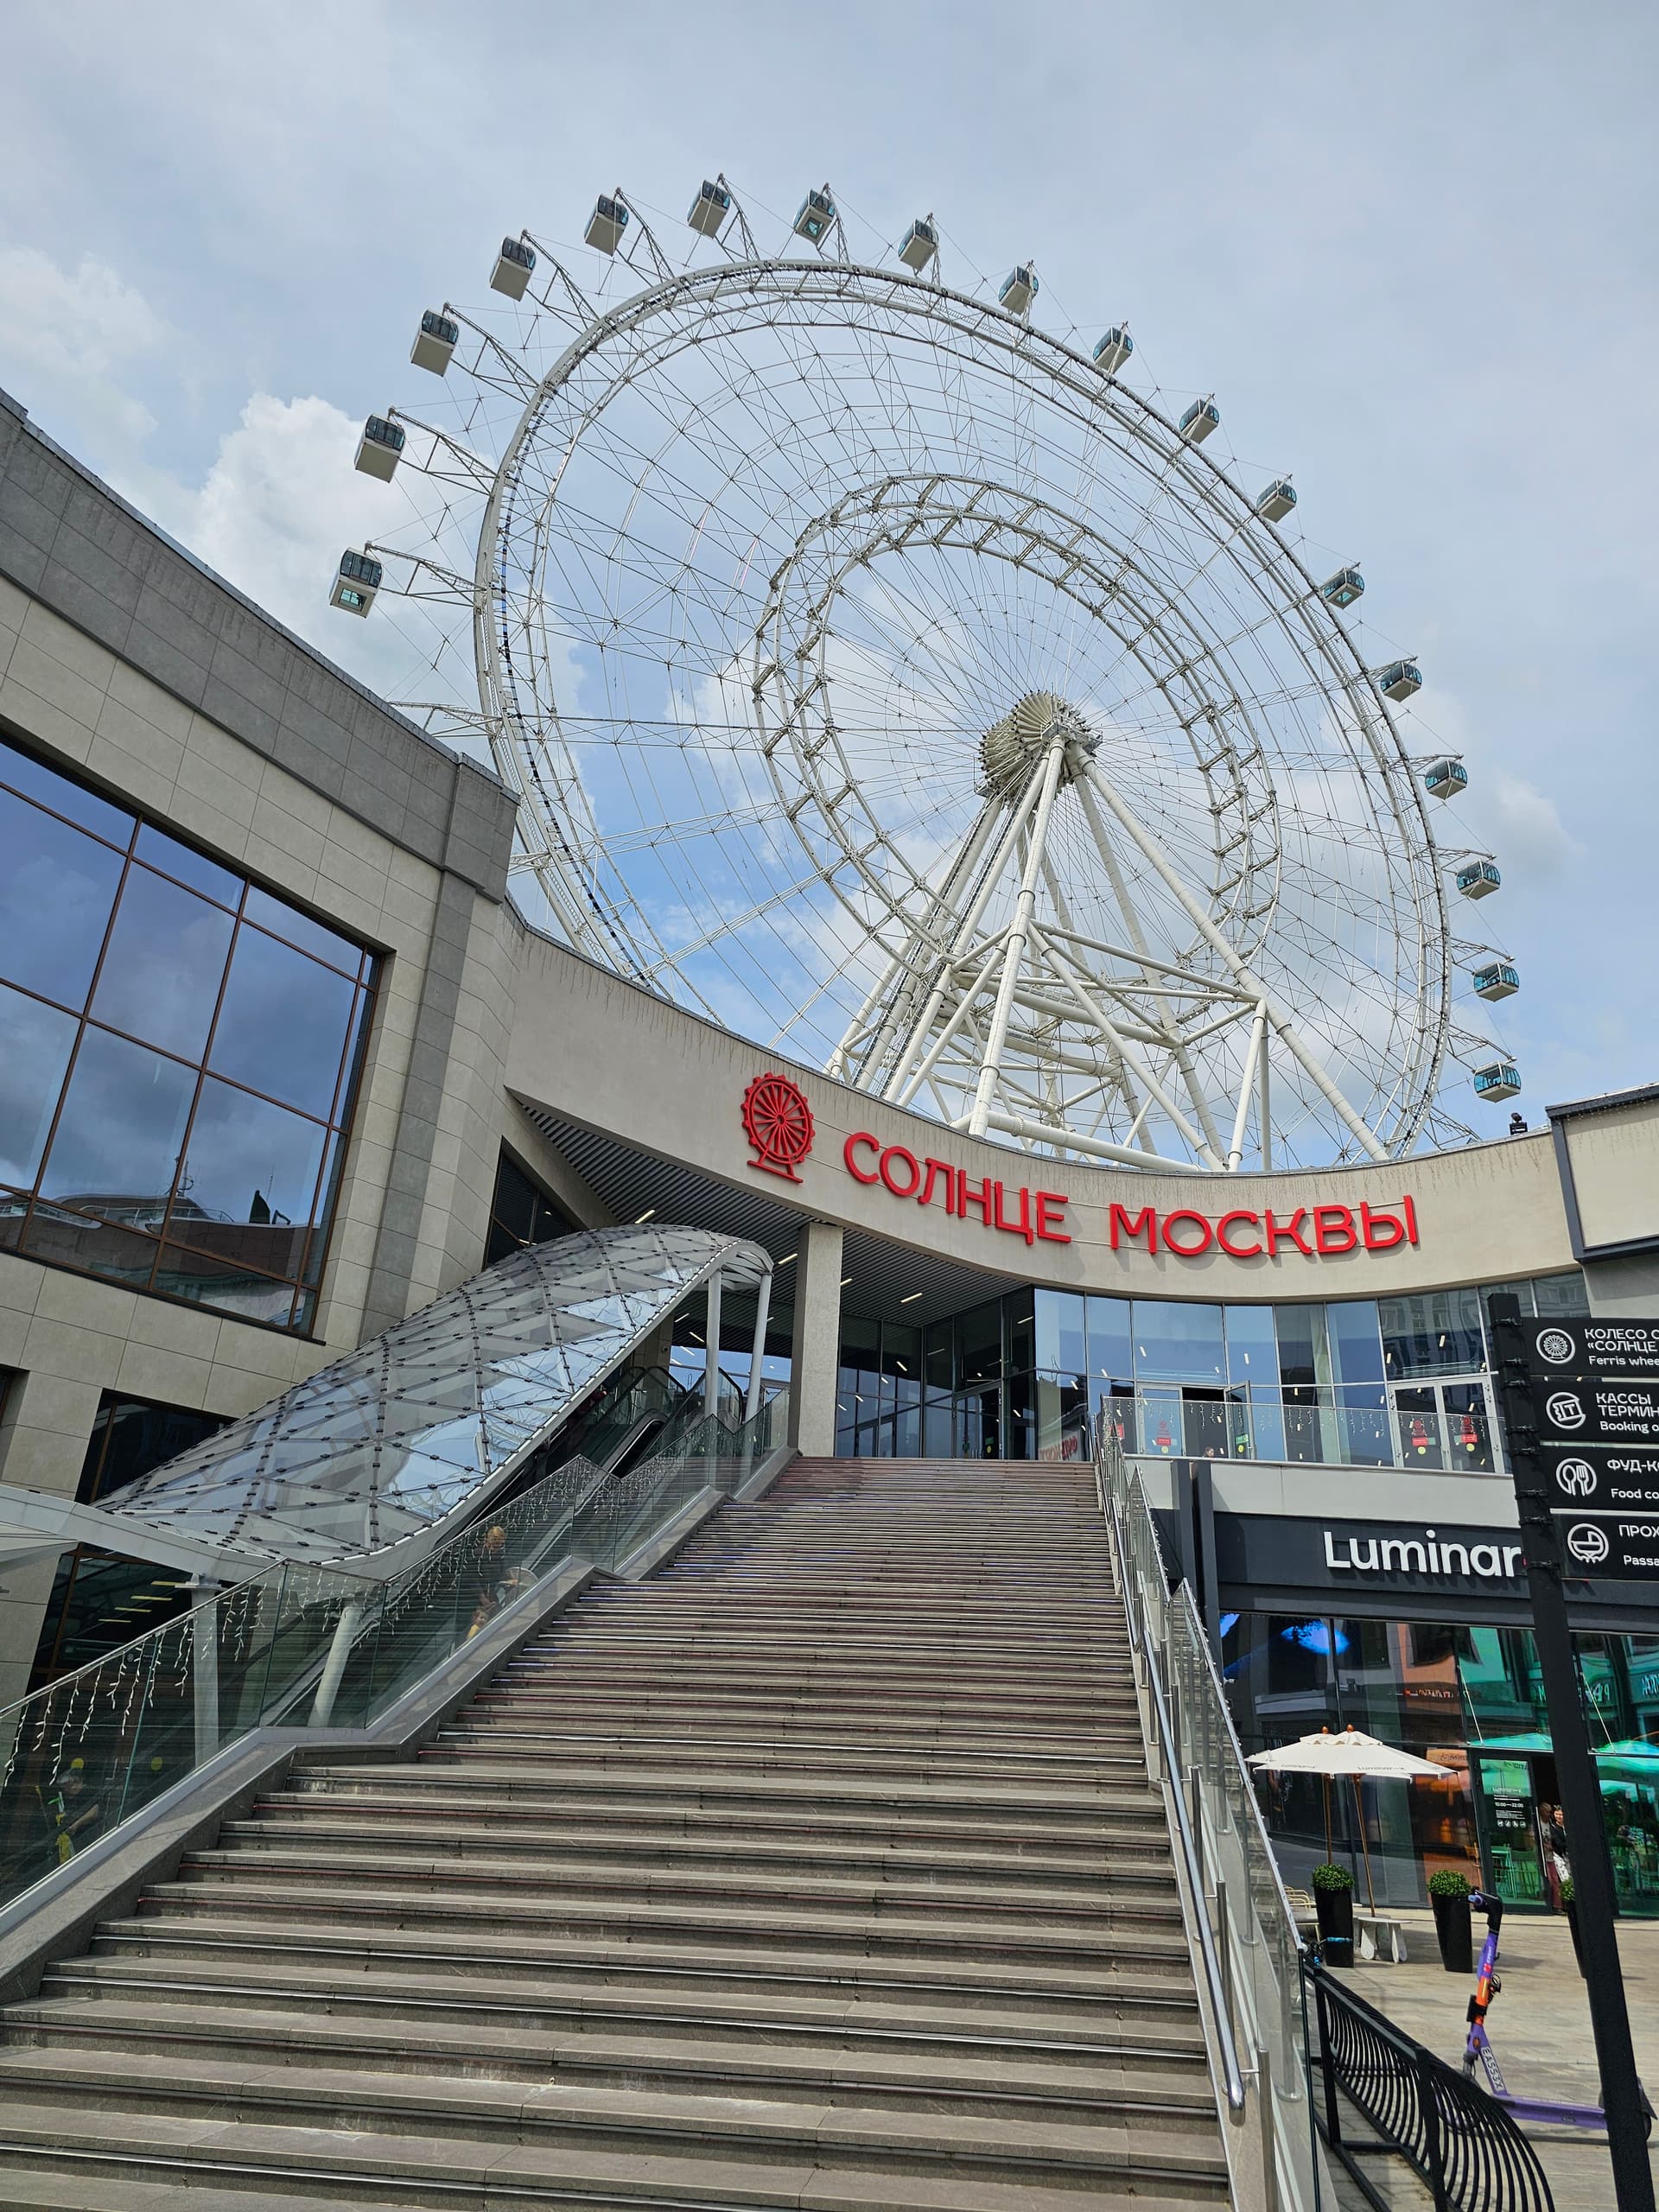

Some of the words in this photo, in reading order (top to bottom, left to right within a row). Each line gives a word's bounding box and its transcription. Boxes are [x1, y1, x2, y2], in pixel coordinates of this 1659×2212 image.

[843, 1131, 1072, 1246] СОЛНЦЕ
[1109, 1194, 1420, 1256] МОСКВЫ
[1585, 1328, 1647, 1339] КОЛЕСО
[1587, 1340, 1658, 1353] «СОЛНЦЕ
[1589, 1355, 1626, 1365] Ferris
[1596, 1392, 1651, 1405] КАССЫ
[1598, 1405, 1659, 1417] ТЕРМИН
[1599, 1421, 1649, 1433] Booking
[1607, 1459, 1659, 1473] ФУД-К
[1611, 1488, 1642, 1498] Food
[1324, 1529, 1522, 1578] Luminar
